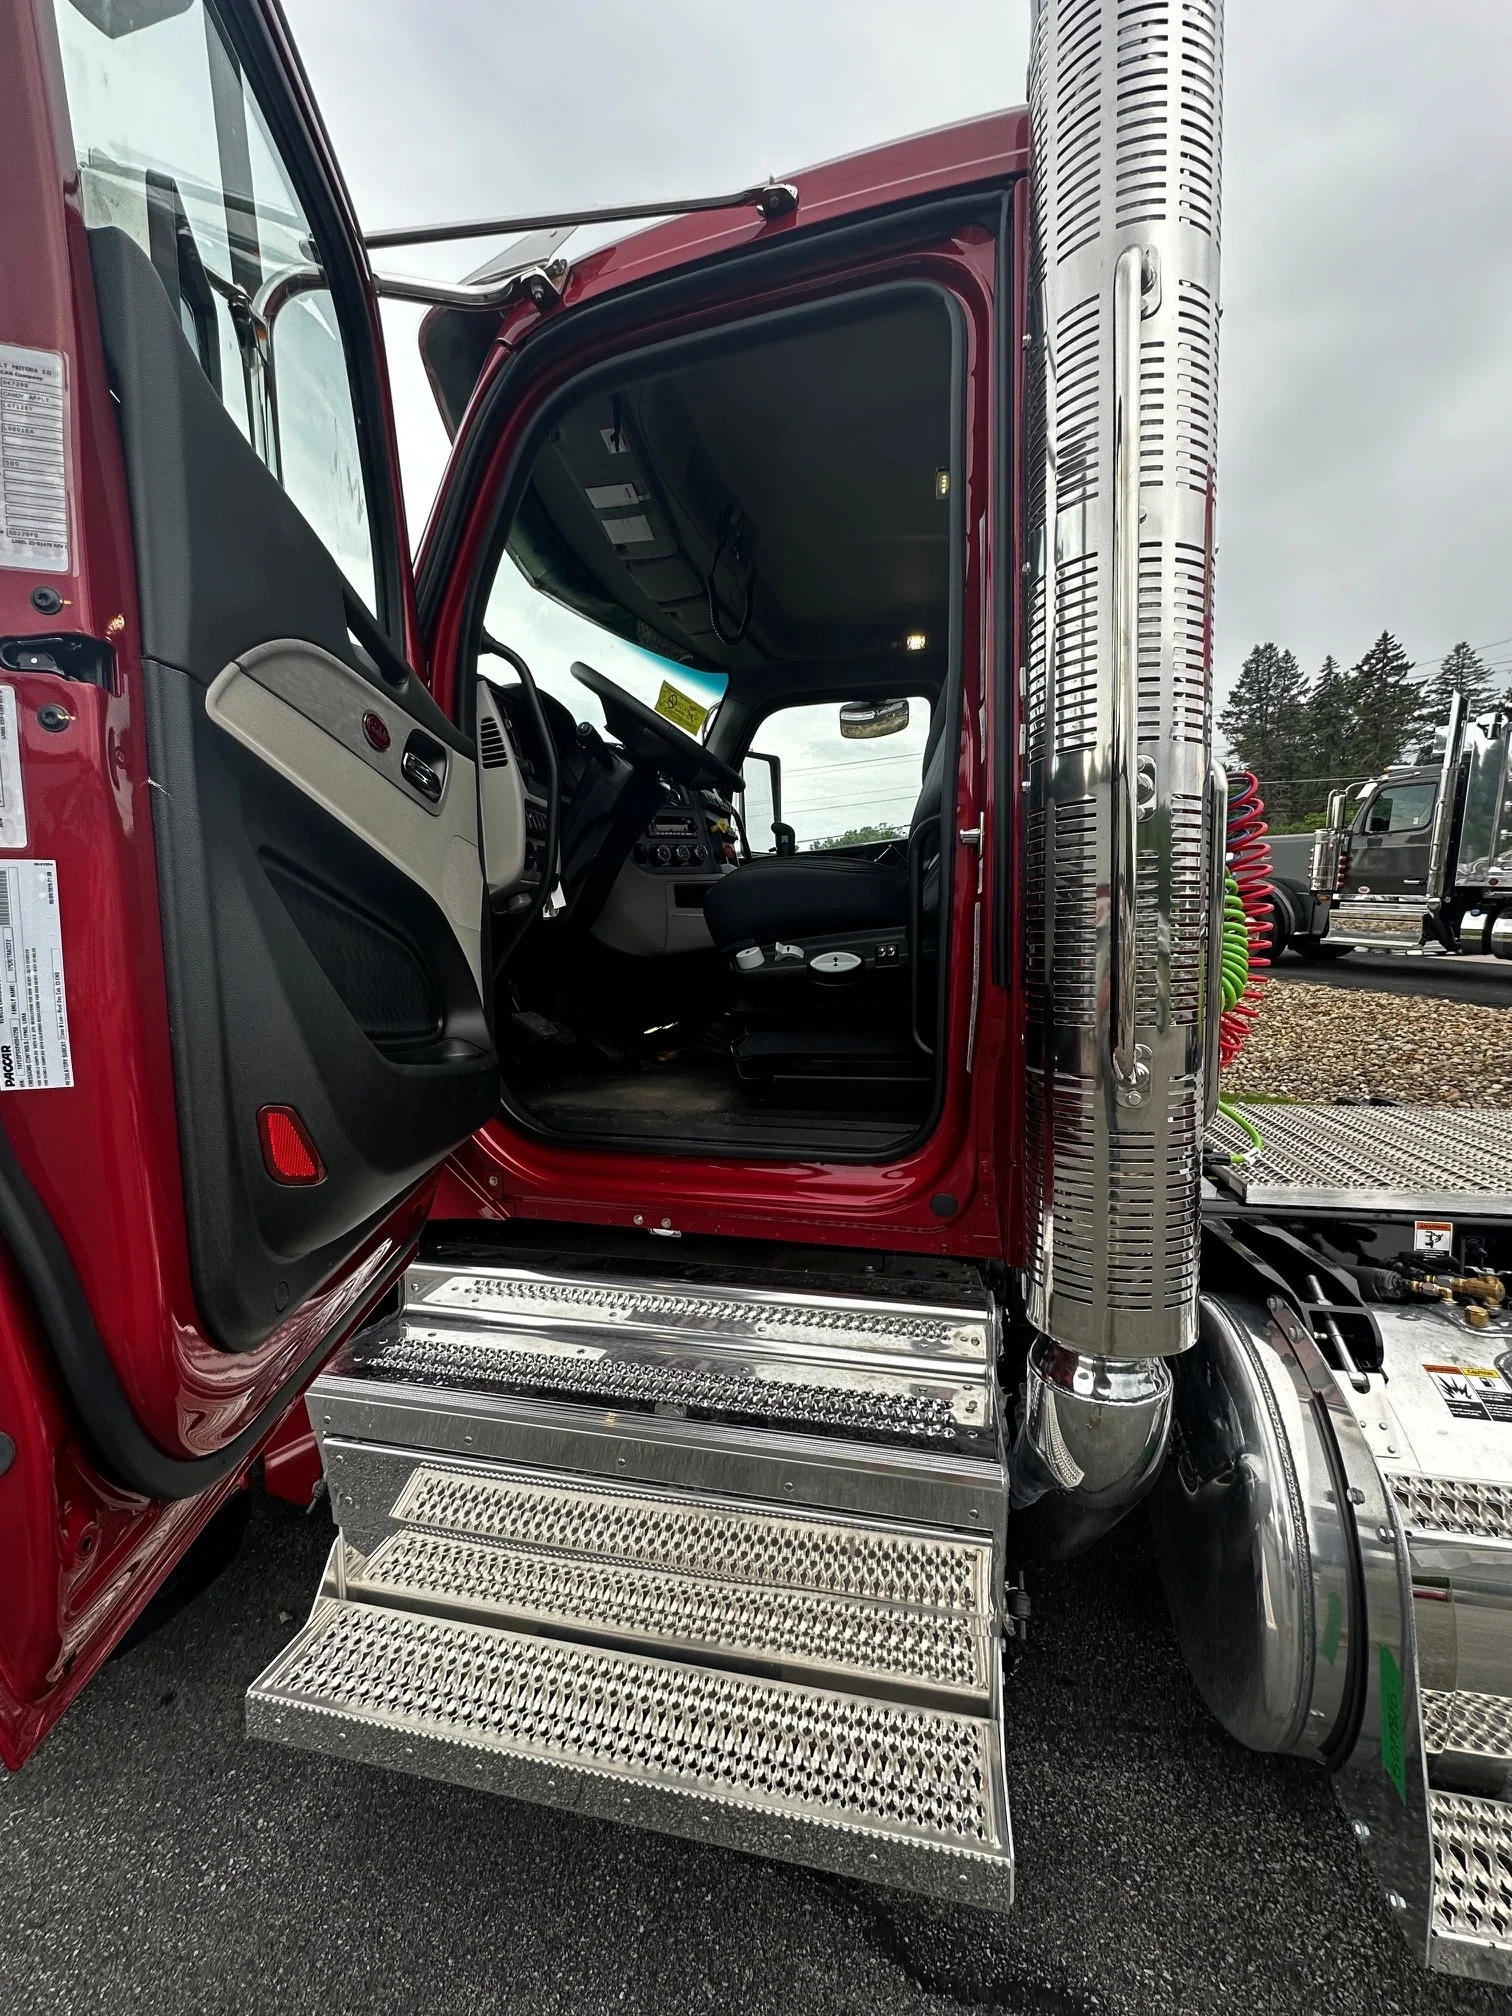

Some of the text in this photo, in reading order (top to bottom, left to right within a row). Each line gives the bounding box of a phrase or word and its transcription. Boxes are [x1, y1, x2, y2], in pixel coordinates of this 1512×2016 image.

[14, 372, 43, 381] Company
[29, 394, 50, 402] APPLE
[1, 1045, 15, 1087] PACCAR
[25, 1064, 33, 1087] EMISSIONS
[62, 1059, 70, 1085] REGULATORY
